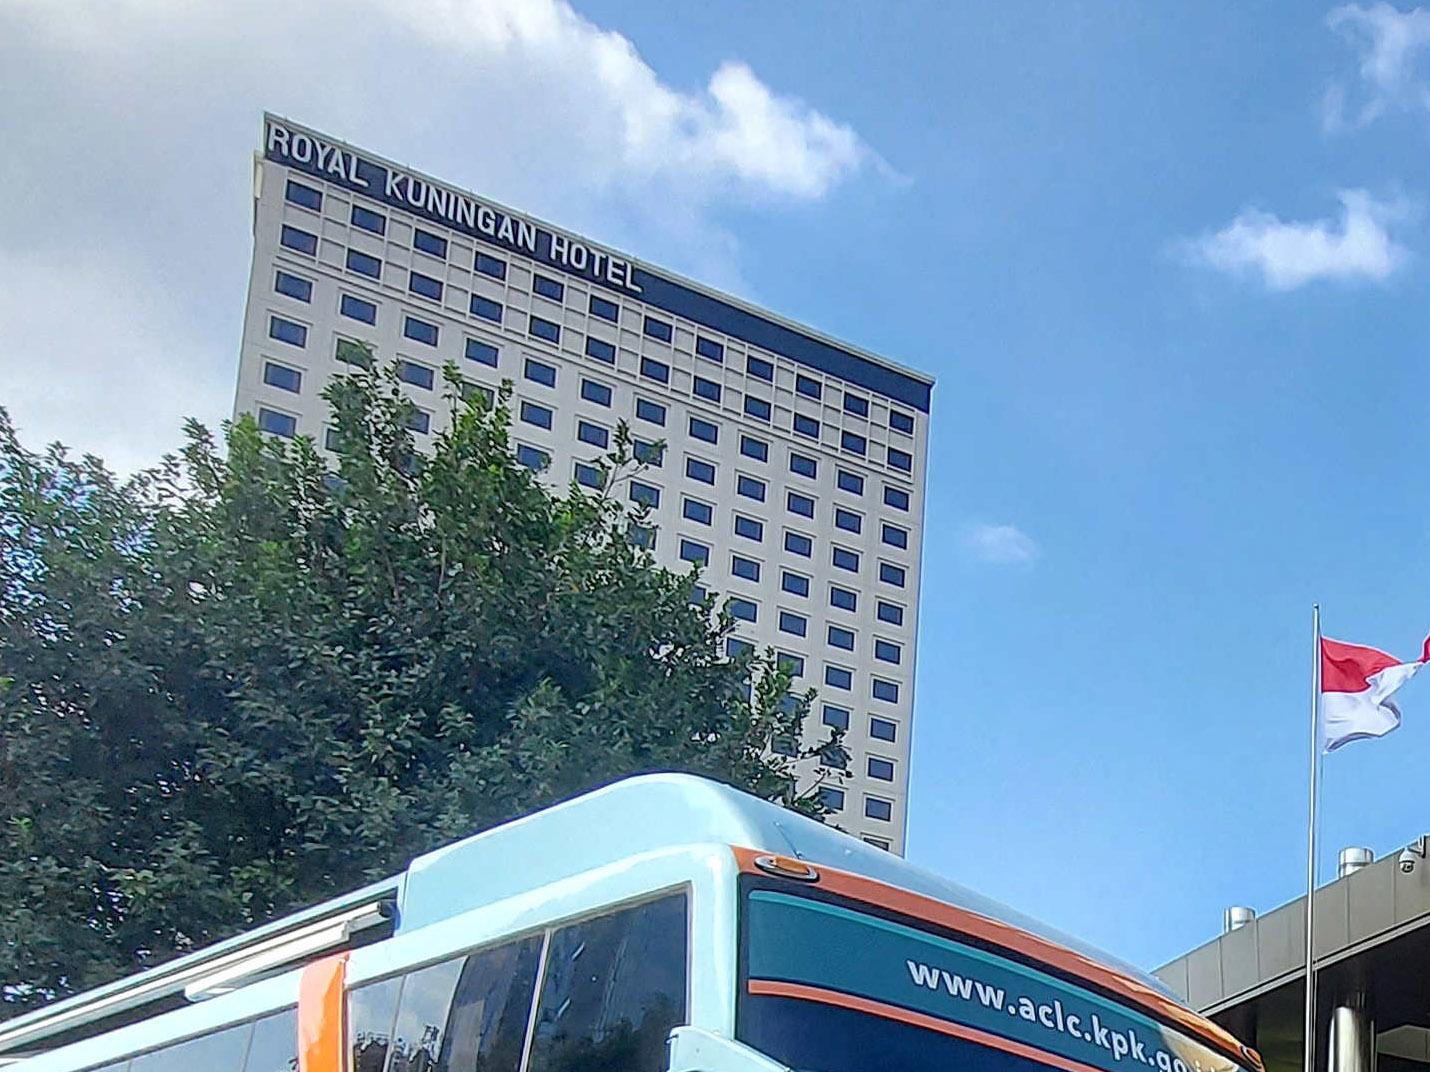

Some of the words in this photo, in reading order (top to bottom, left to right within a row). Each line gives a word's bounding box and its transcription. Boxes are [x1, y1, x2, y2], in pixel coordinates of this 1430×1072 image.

[266, 123, 370, 188] ROYAL
[384, 167, 537, 254] KUNINGAN
[550, 232, 645, 294] HOTEL
